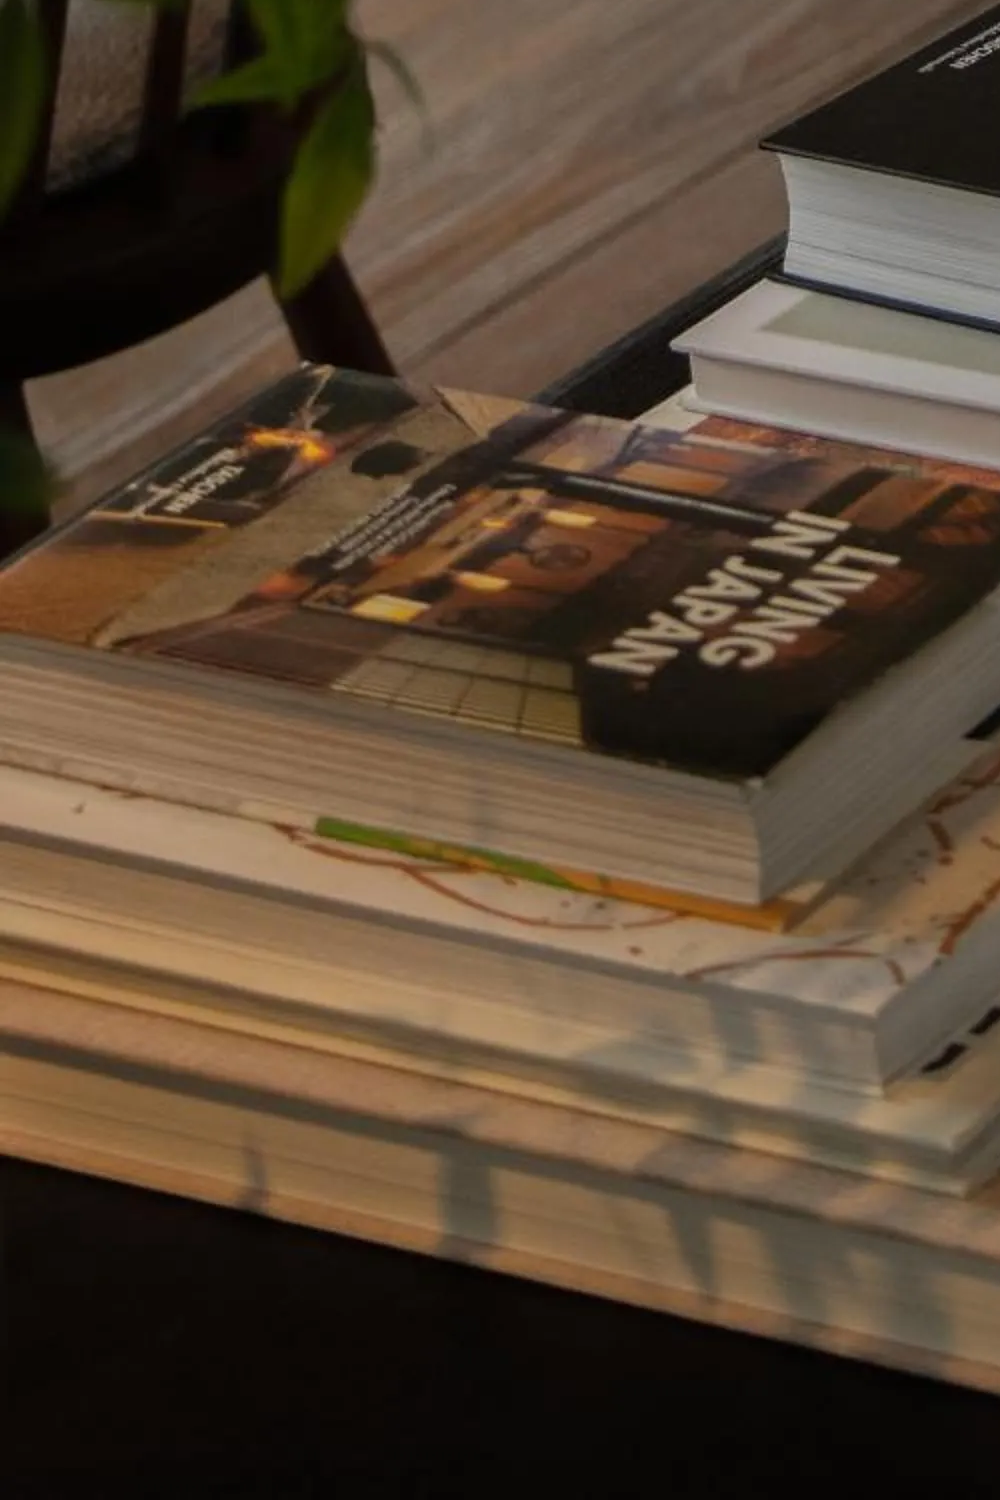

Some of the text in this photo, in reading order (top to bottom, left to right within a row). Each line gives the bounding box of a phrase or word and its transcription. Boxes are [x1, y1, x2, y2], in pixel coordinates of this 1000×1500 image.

[587, 509, 852, 676] IN JAPAN
[699, 545, 901, 668] LIVING
